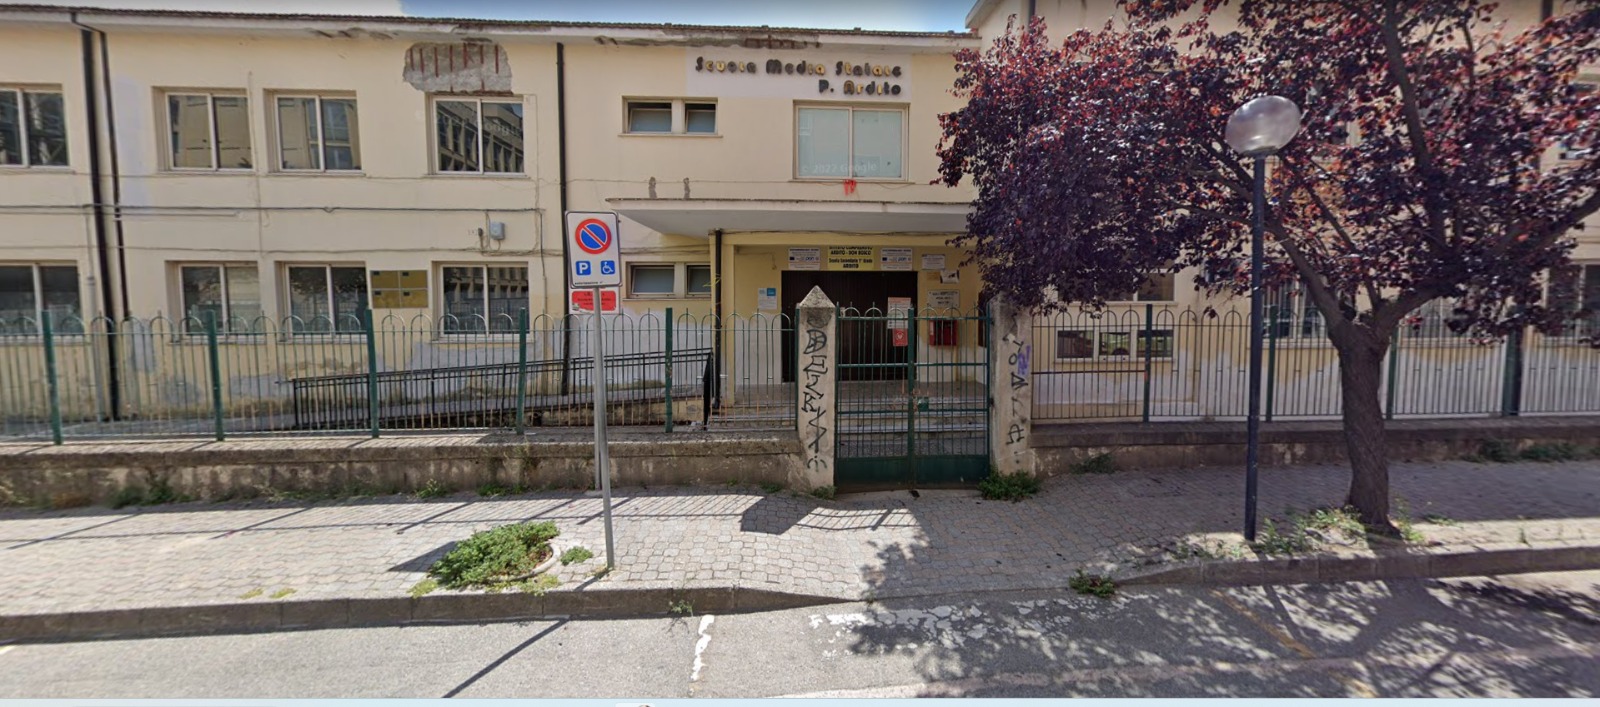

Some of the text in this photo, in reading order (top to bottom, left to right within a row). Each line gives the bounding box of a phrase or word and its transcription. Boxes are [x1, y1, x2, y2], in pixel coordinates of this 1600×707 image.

[695, 56, 902, 78] Scuola Media Statale
[818, 79, 902, 95] P. Ardito
[578, 262, 589, 274] P
